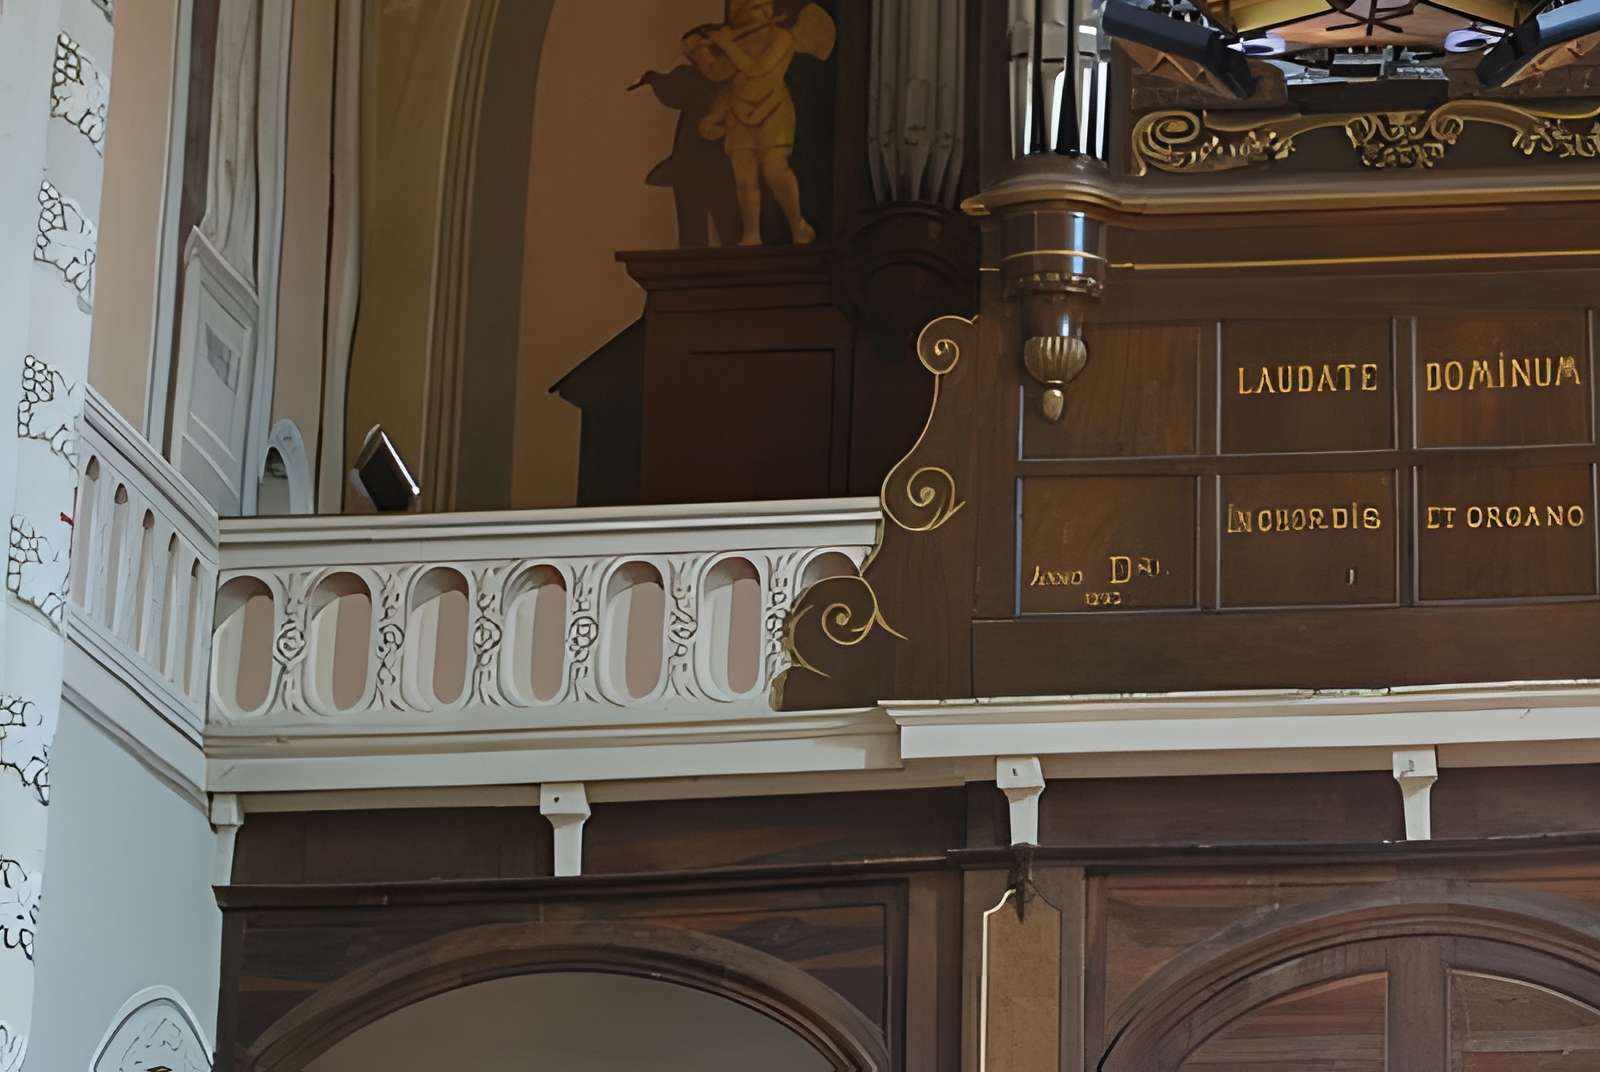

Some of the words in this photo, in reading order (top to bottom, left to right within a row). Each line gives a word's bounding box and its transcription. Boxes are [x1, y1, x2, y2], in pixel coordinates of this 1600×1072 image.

[1238, 363, 1377, 395] LAUDATE
[1426, 352, 1581, 392] DOMINUM
[1427, 506, 1457, 529] ET
